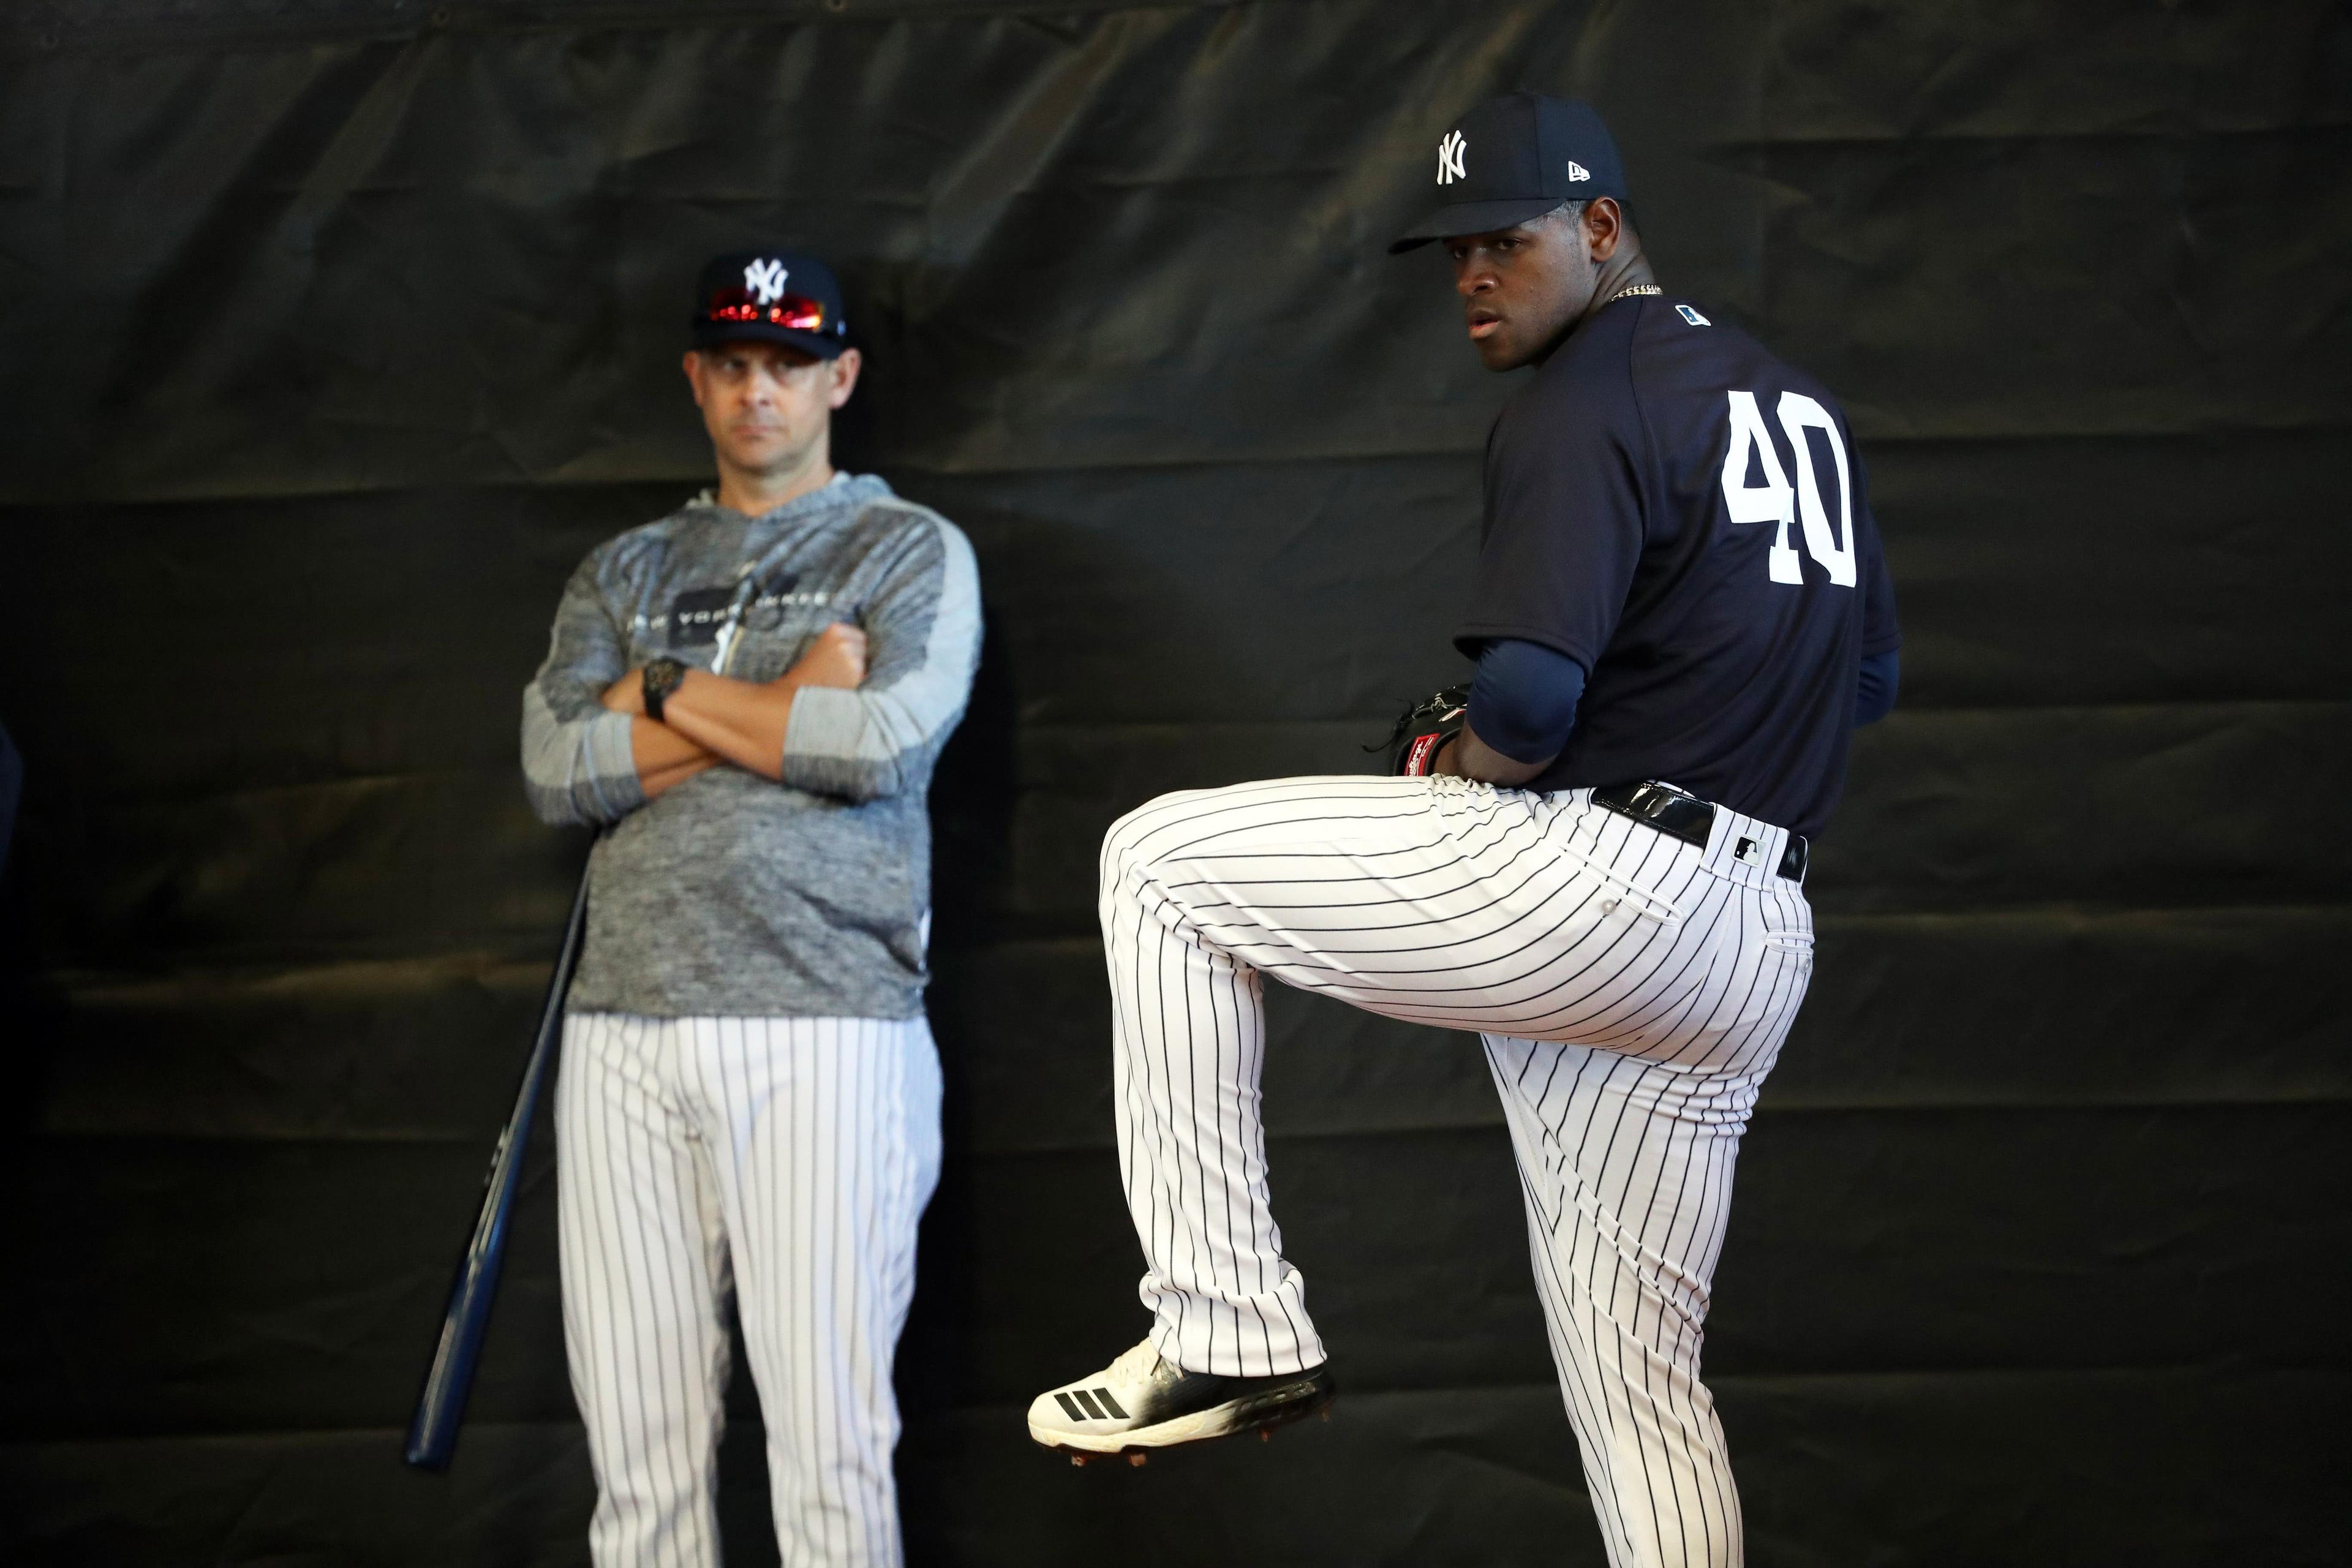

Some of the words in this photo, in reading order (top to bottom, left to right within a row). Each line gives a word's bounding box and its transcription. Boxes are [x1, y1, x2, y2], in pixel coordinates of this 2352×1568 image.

[1437, 130, 1467, 185] NY
[744, 257, 790, 305] NY
[1721, 390, 1857, 588] 40
